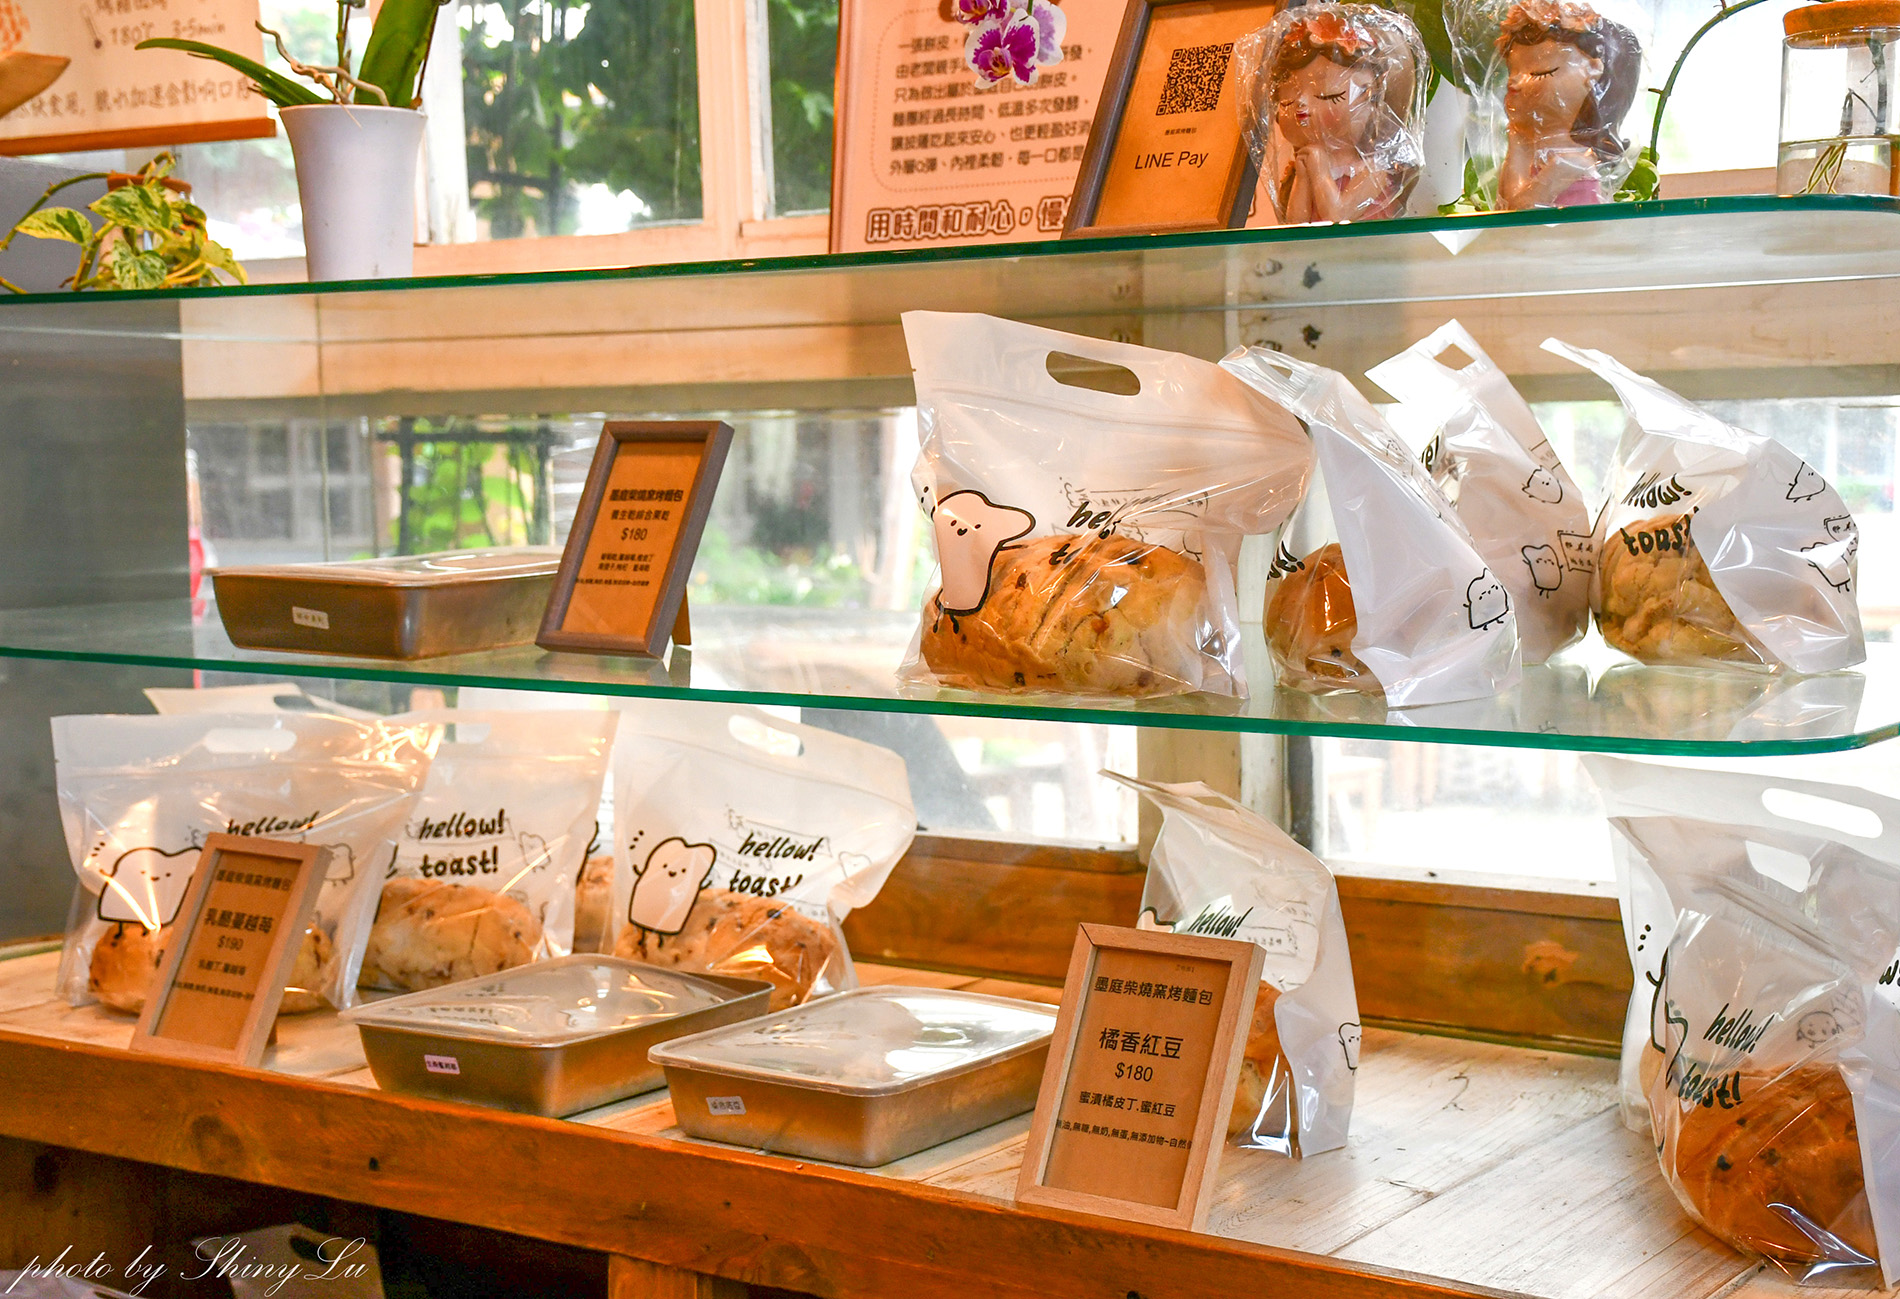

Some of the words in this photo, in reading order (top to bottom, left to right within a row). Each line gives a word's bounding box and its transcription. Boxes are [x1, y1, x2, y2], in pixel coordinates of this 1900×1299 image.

[1134, 152, 1174, 169] LINE
[1177, 150, 1209, 168] Pay
[621, 527, 648, 541] $180
[419, 808, 505, 840] hellow!
[420, 845, 498, 878] toast!
[738, 832, 824, 862] hellow!
[1188, 904, 1254, 938] hellow!
[1094, 976, 1213, 1006] 墨庭柴燒窯烤麵包
[1099, 1027, 1184, 1059] 橘香紅豆
[1703, 1003, 1775, 1053] hellow!
[1115, 1062, 1153, 1082] $180
